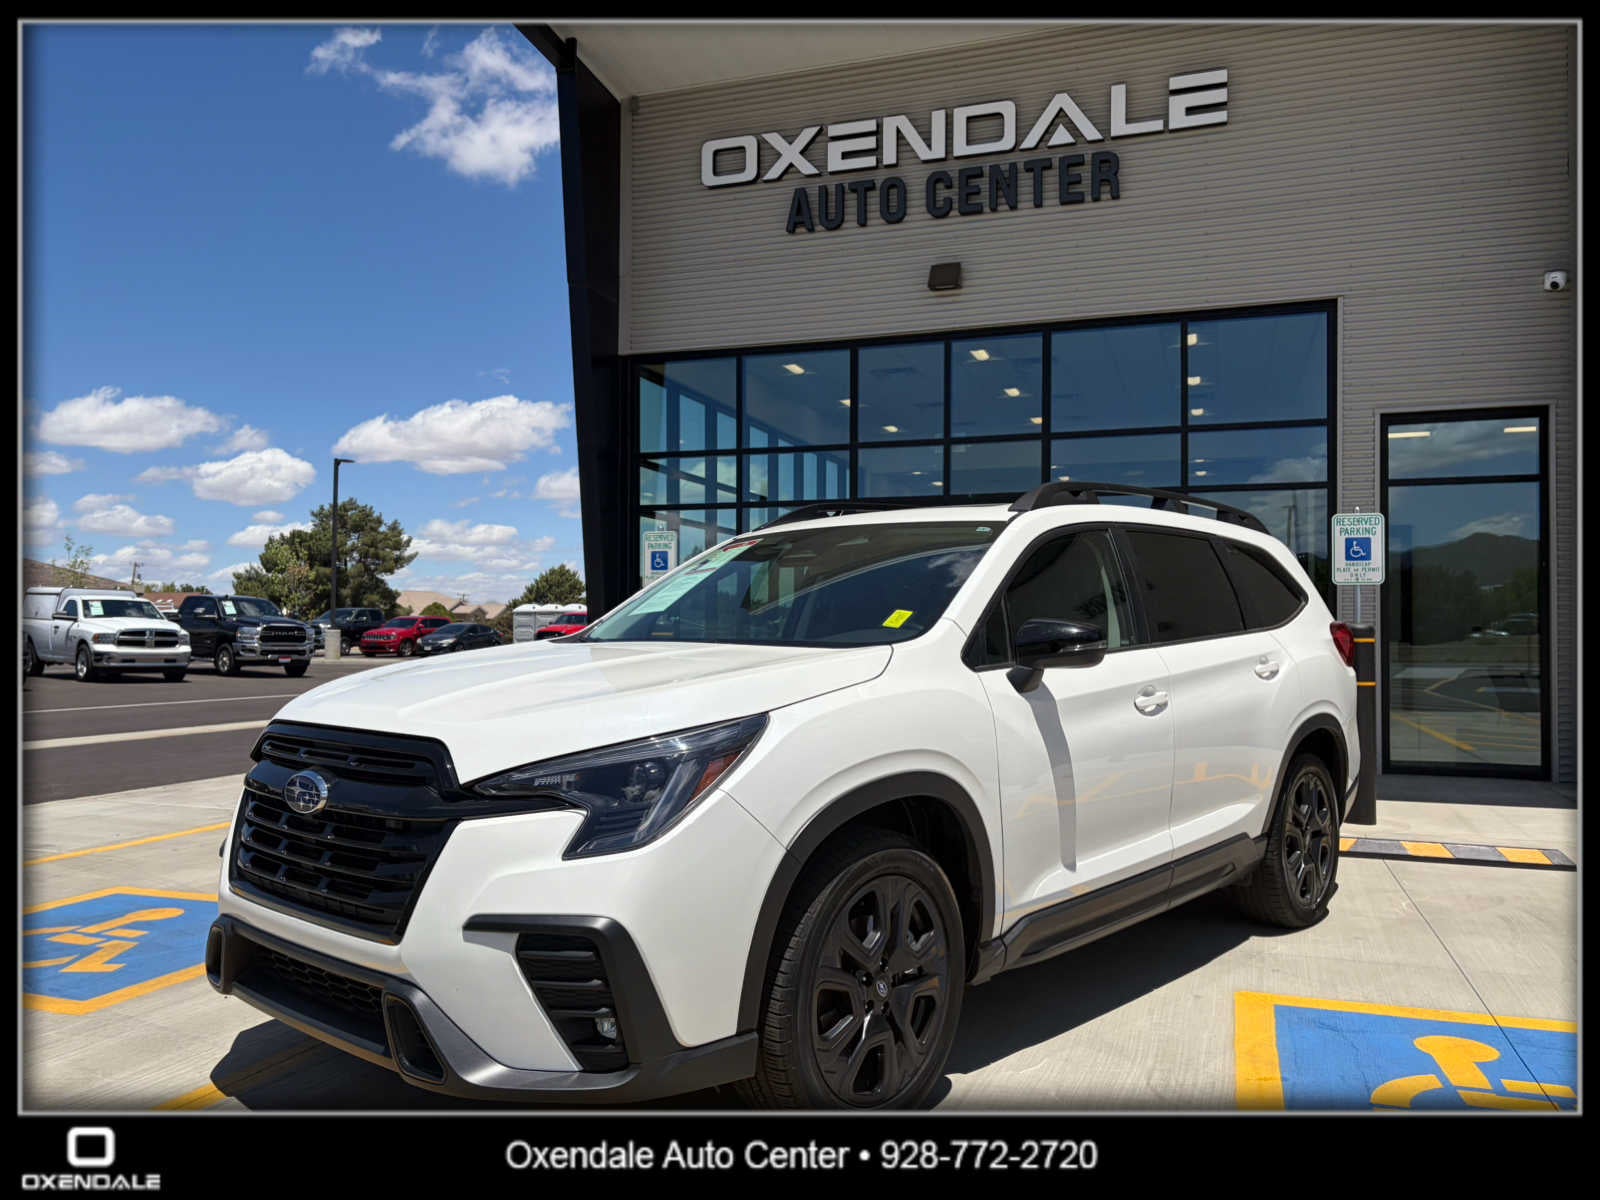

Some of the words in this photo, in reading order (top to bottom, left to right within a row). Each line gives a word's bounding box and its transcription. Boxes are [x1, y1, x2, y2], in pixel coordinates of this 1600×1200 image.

[701, 68, 1229, 188] OXENDALE
[785, 177, 907, 234] AUTO
[925, 150, 1121, 219] CENTER
[1335, 516, 1381, 527] RESERVED
[1339, 526, 1377, 537] PARKING
